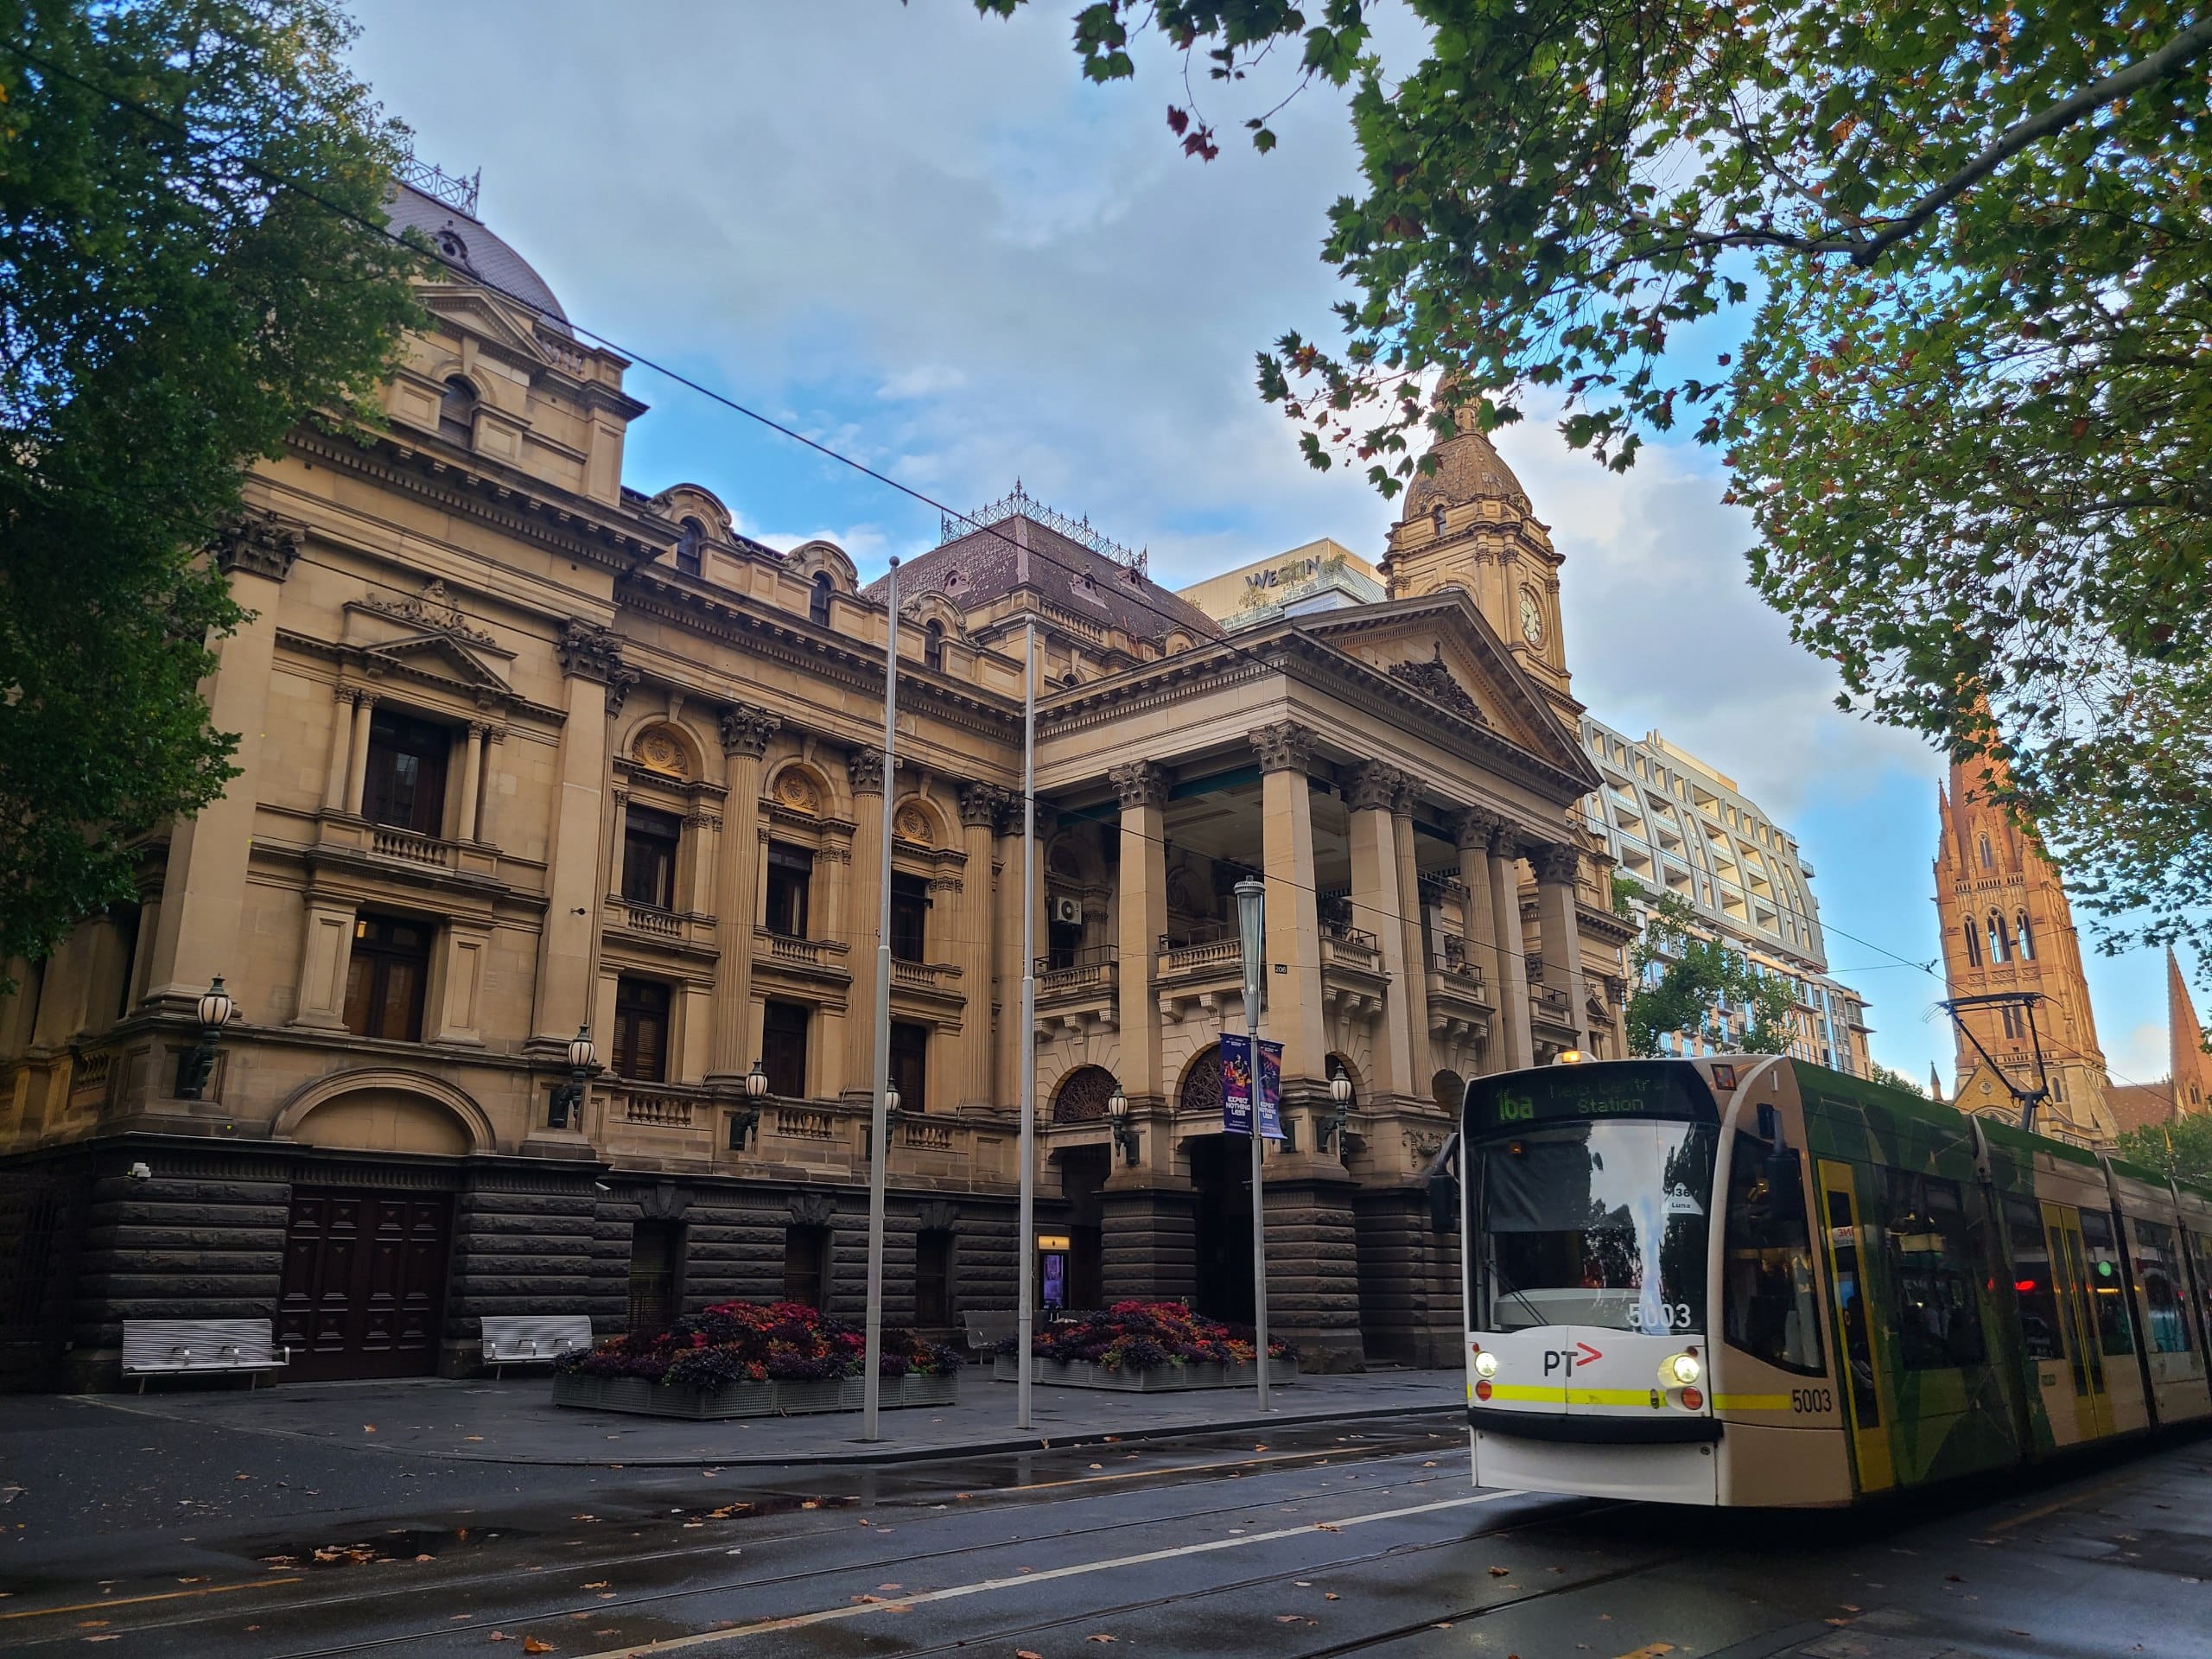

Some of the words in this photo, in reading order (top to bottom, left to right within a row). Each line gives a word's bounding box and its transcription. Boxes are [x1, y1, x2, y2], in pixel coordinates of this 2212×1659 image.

[1245, 555, 1319, 589] WESIN
[1577, 1096, 1643, 1114] Station
[1627, 1303, 1691, 1328] 5003
[1792, 1389, 1832, 1413] 5003
